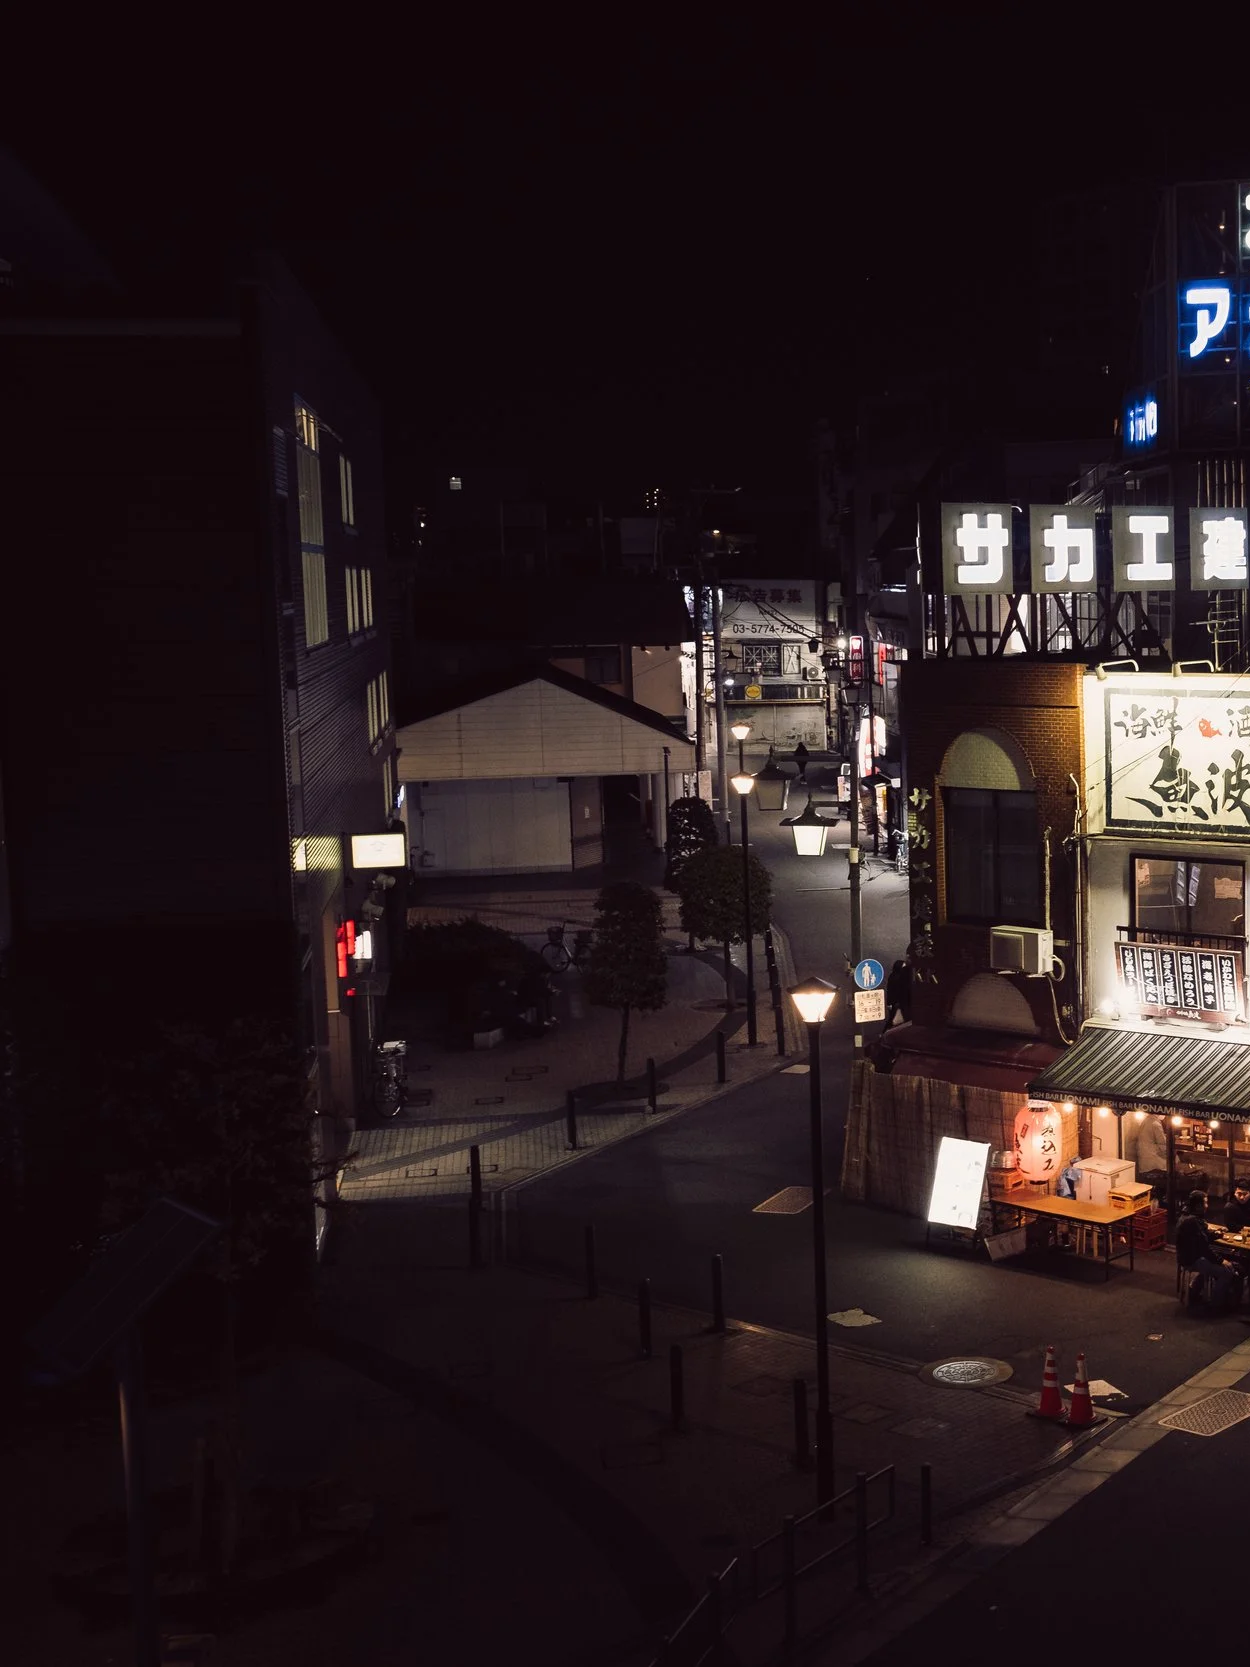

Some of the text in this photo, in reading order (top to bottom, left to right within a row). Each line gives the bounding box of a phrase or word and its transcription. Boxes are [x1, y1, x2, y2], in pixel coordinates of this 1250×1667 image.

[1114, 697, 1183, 750] 海鮮
[1060, 1093, 1101, 1106] UONAMI
[1134, 1102, 1176, 1115] UONAMI
